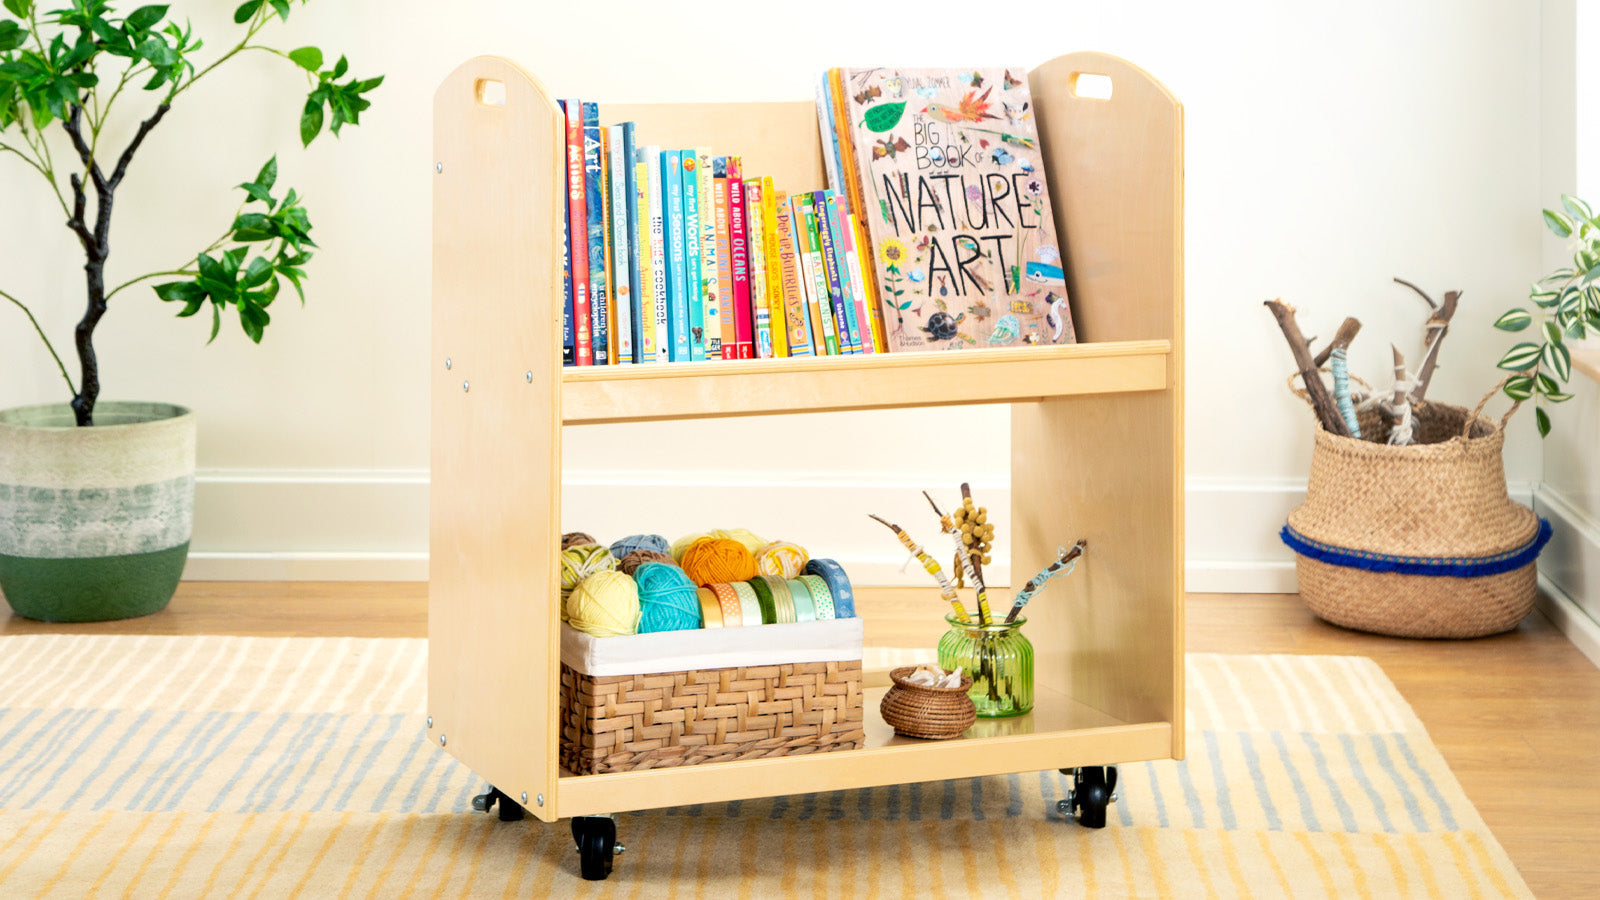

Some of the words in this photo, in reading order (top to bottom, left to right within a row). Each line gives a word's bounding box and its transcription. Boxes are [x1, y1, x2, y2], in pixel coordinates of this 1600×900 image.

[914, 122, 940, 145] BIG
[585, 135, 602, 173] Art
[915, 144, 976, 170] BOOK
[975, 152, 984, 163] OF
[568, 143, 585, 200] ARTISTS
[615, 181, 624, 200] Seas
[671, 183, 679, 196] my
[686, 184, 694, 197] my
[715, 182, 724, 204] WILD
[731, 182, 740, 204] WILD
[615, 202, 624, 216] and
[673, 197, 681, 212] first
[688, 197, 696, 212] first
[883, 172, 1038, 237] NATURE
[653, 216, 662, 234] the
[716, 207, 726, 235] ABOUT
[732, 206, 743, 234] ABOUT
[832, 210, 844, 254] Fingerwiggly
[671, 213, 683, 263] Seasons
[687, 213, 701, 257] Words
[769, 232, 777, 258] MOUSE
[819, 201, 832, 247] Fingerwiggly
[826, 247, 838, 282] Elephants
[717, 239, 730, 281] PLANET
[733, 238, 746, 282] OCEANS
[813, 256, 824, 279] BABY
[929, 235, 1013, 297] ART
[591, 283, 600, 337] encyclopedia
[655, 269, 667, 325] cookbook
[719, 287, 732, 324] EARTH
[772, 285, 781, 311] SORRY
[816, 281, 832, 330] BOTANIST
[599, 291, 607, 335] children's
[836, 302, 846, 329] Usborne
[848, 302, 857, 327] Usborne
